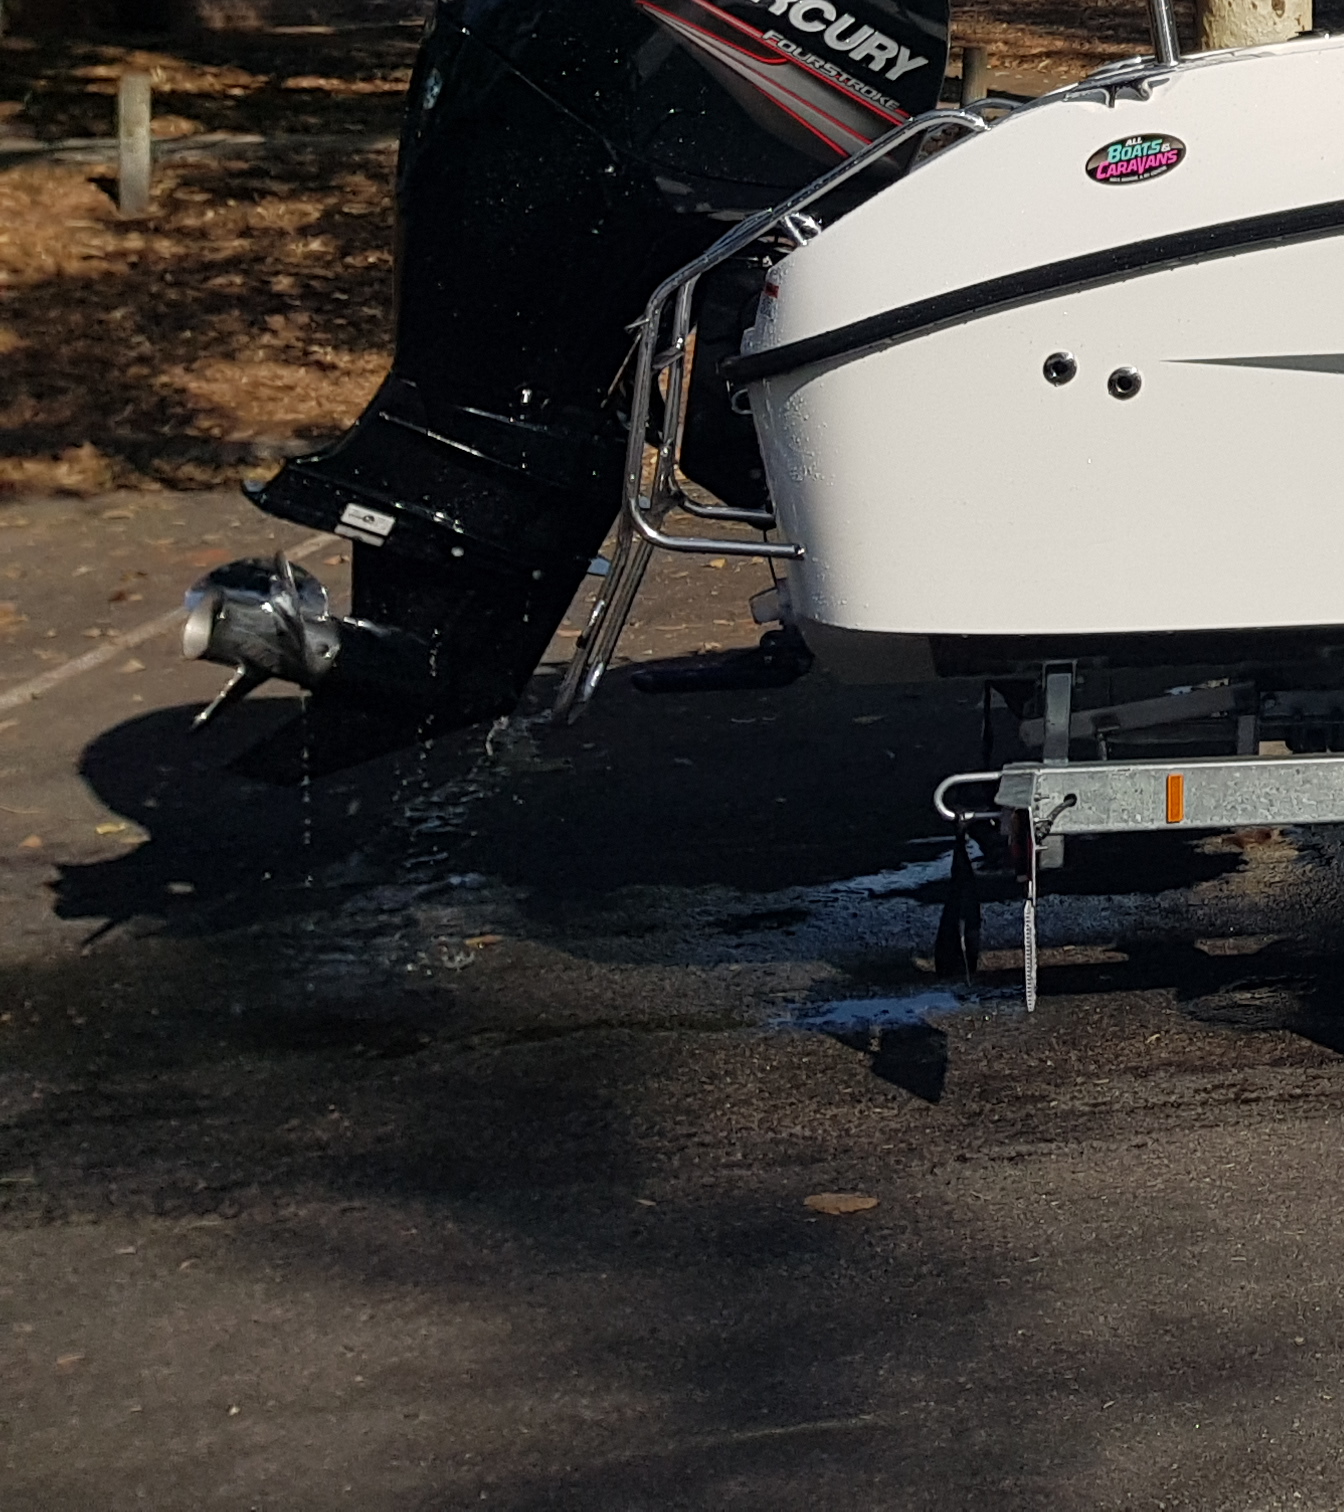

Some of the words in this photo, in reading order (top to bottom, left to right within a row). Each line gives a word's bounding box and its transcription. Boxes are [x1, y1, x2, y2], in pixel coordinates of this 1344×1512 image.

[762, 29, 900, 110] FOURSTROKE
[1107, 138, 1163, 163] BOATS
[1125, 136, 1143, 147] ALL
[1096, 149, 1178, 180] CARAVANS
